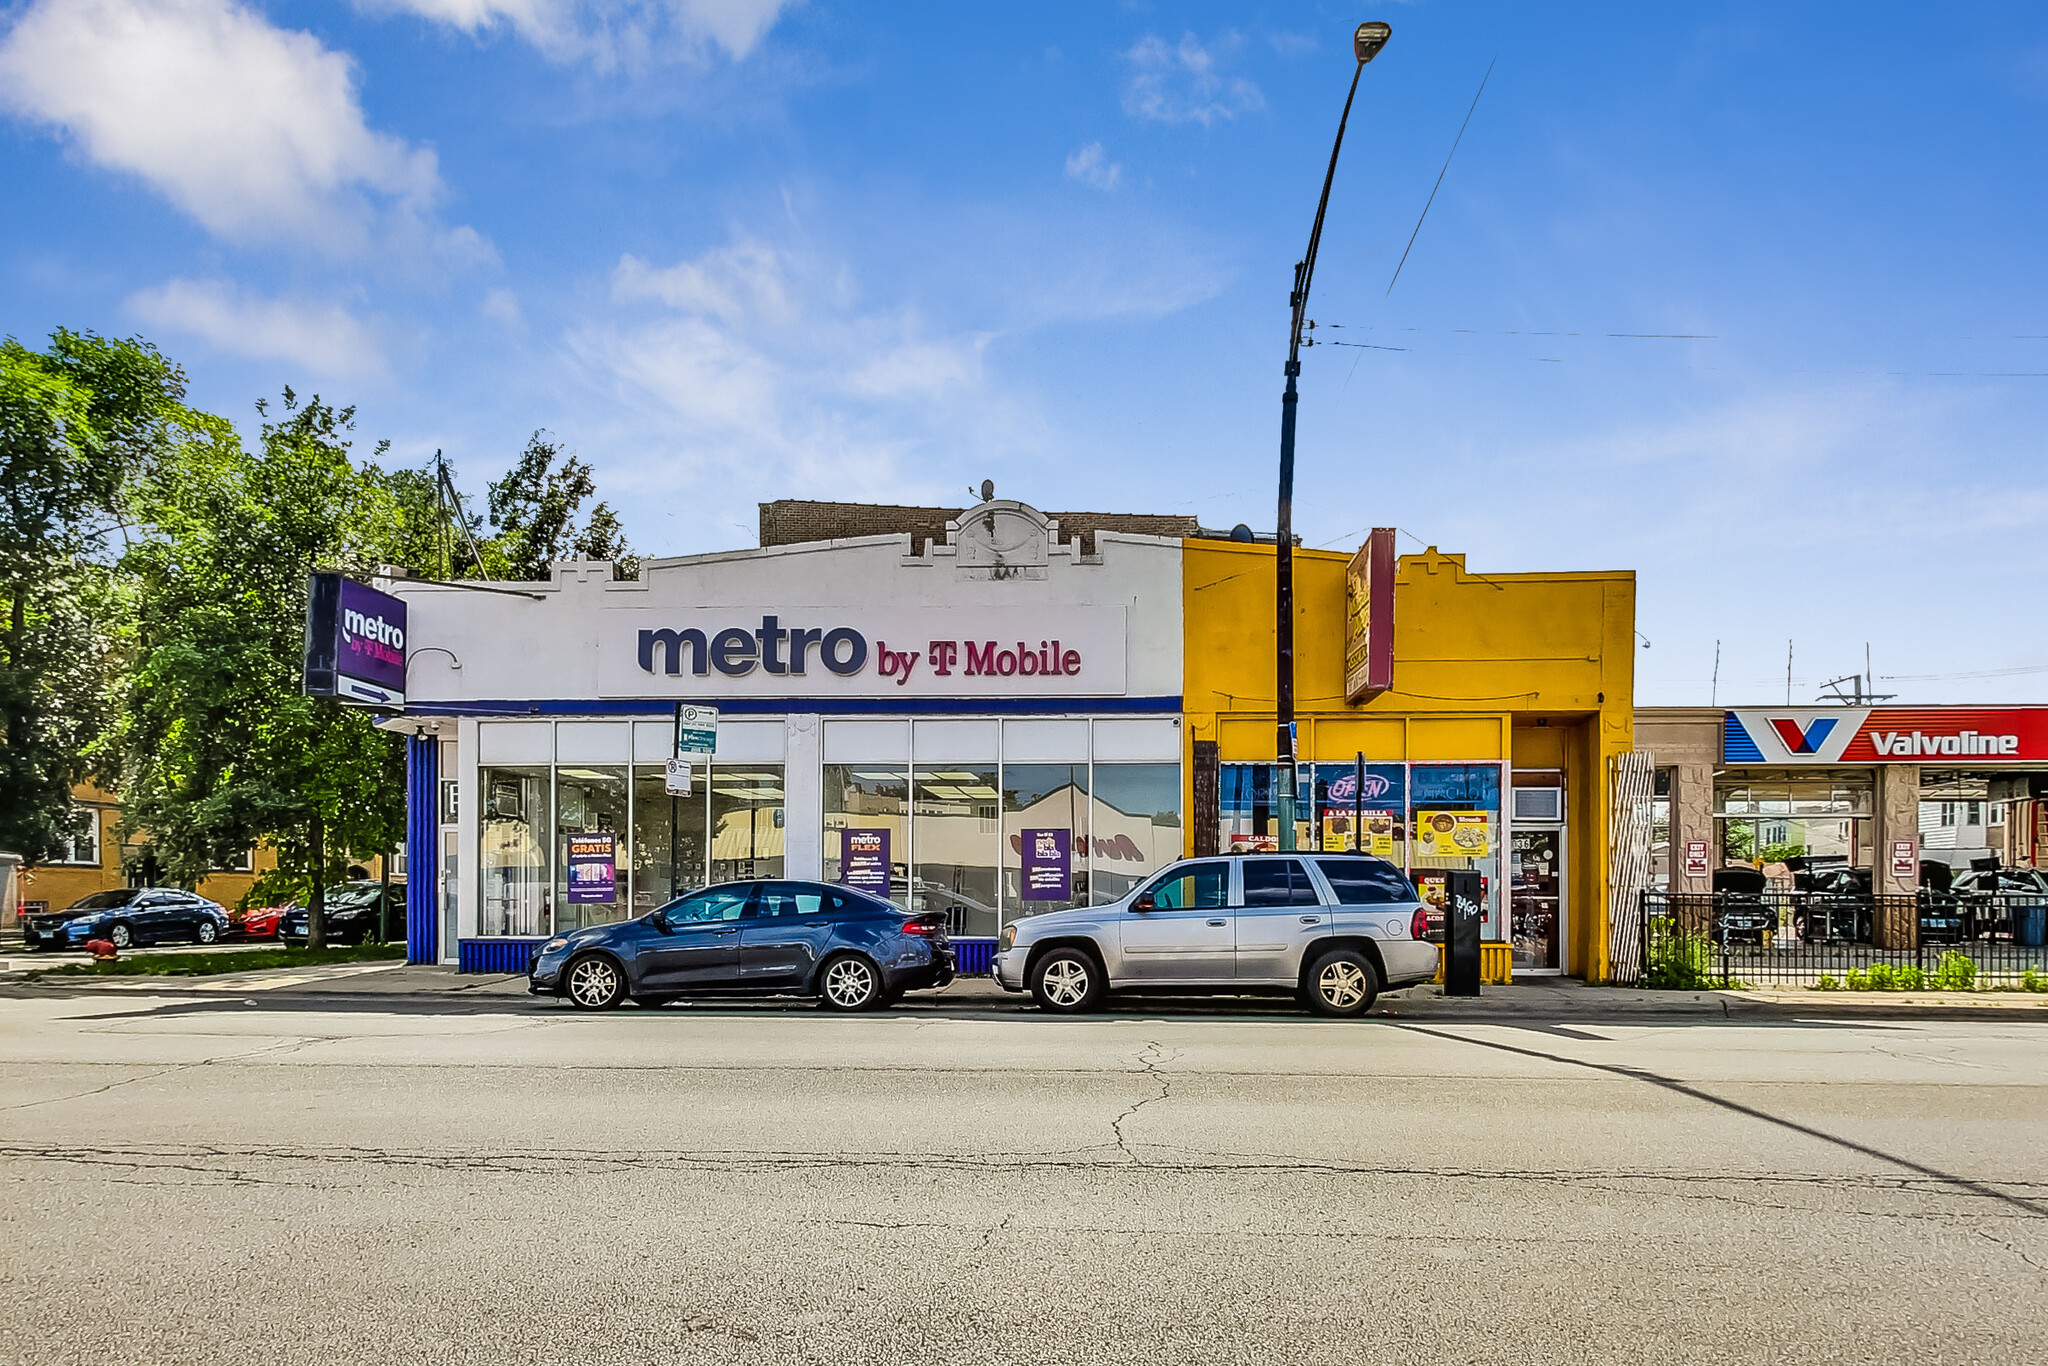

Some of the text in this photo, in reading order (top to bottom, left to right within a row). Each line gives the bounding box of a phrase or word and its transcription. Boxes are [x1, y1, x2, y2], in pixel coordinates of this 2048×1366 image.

[342, 608, 404, 650] metro
[637, 614, 1081, 686] metro by T Mobile
[1869, 730, 2020, 756] Valvoline
[571, 844, 612, 853] GRATIS
[851, 835, 880, 844] metro
